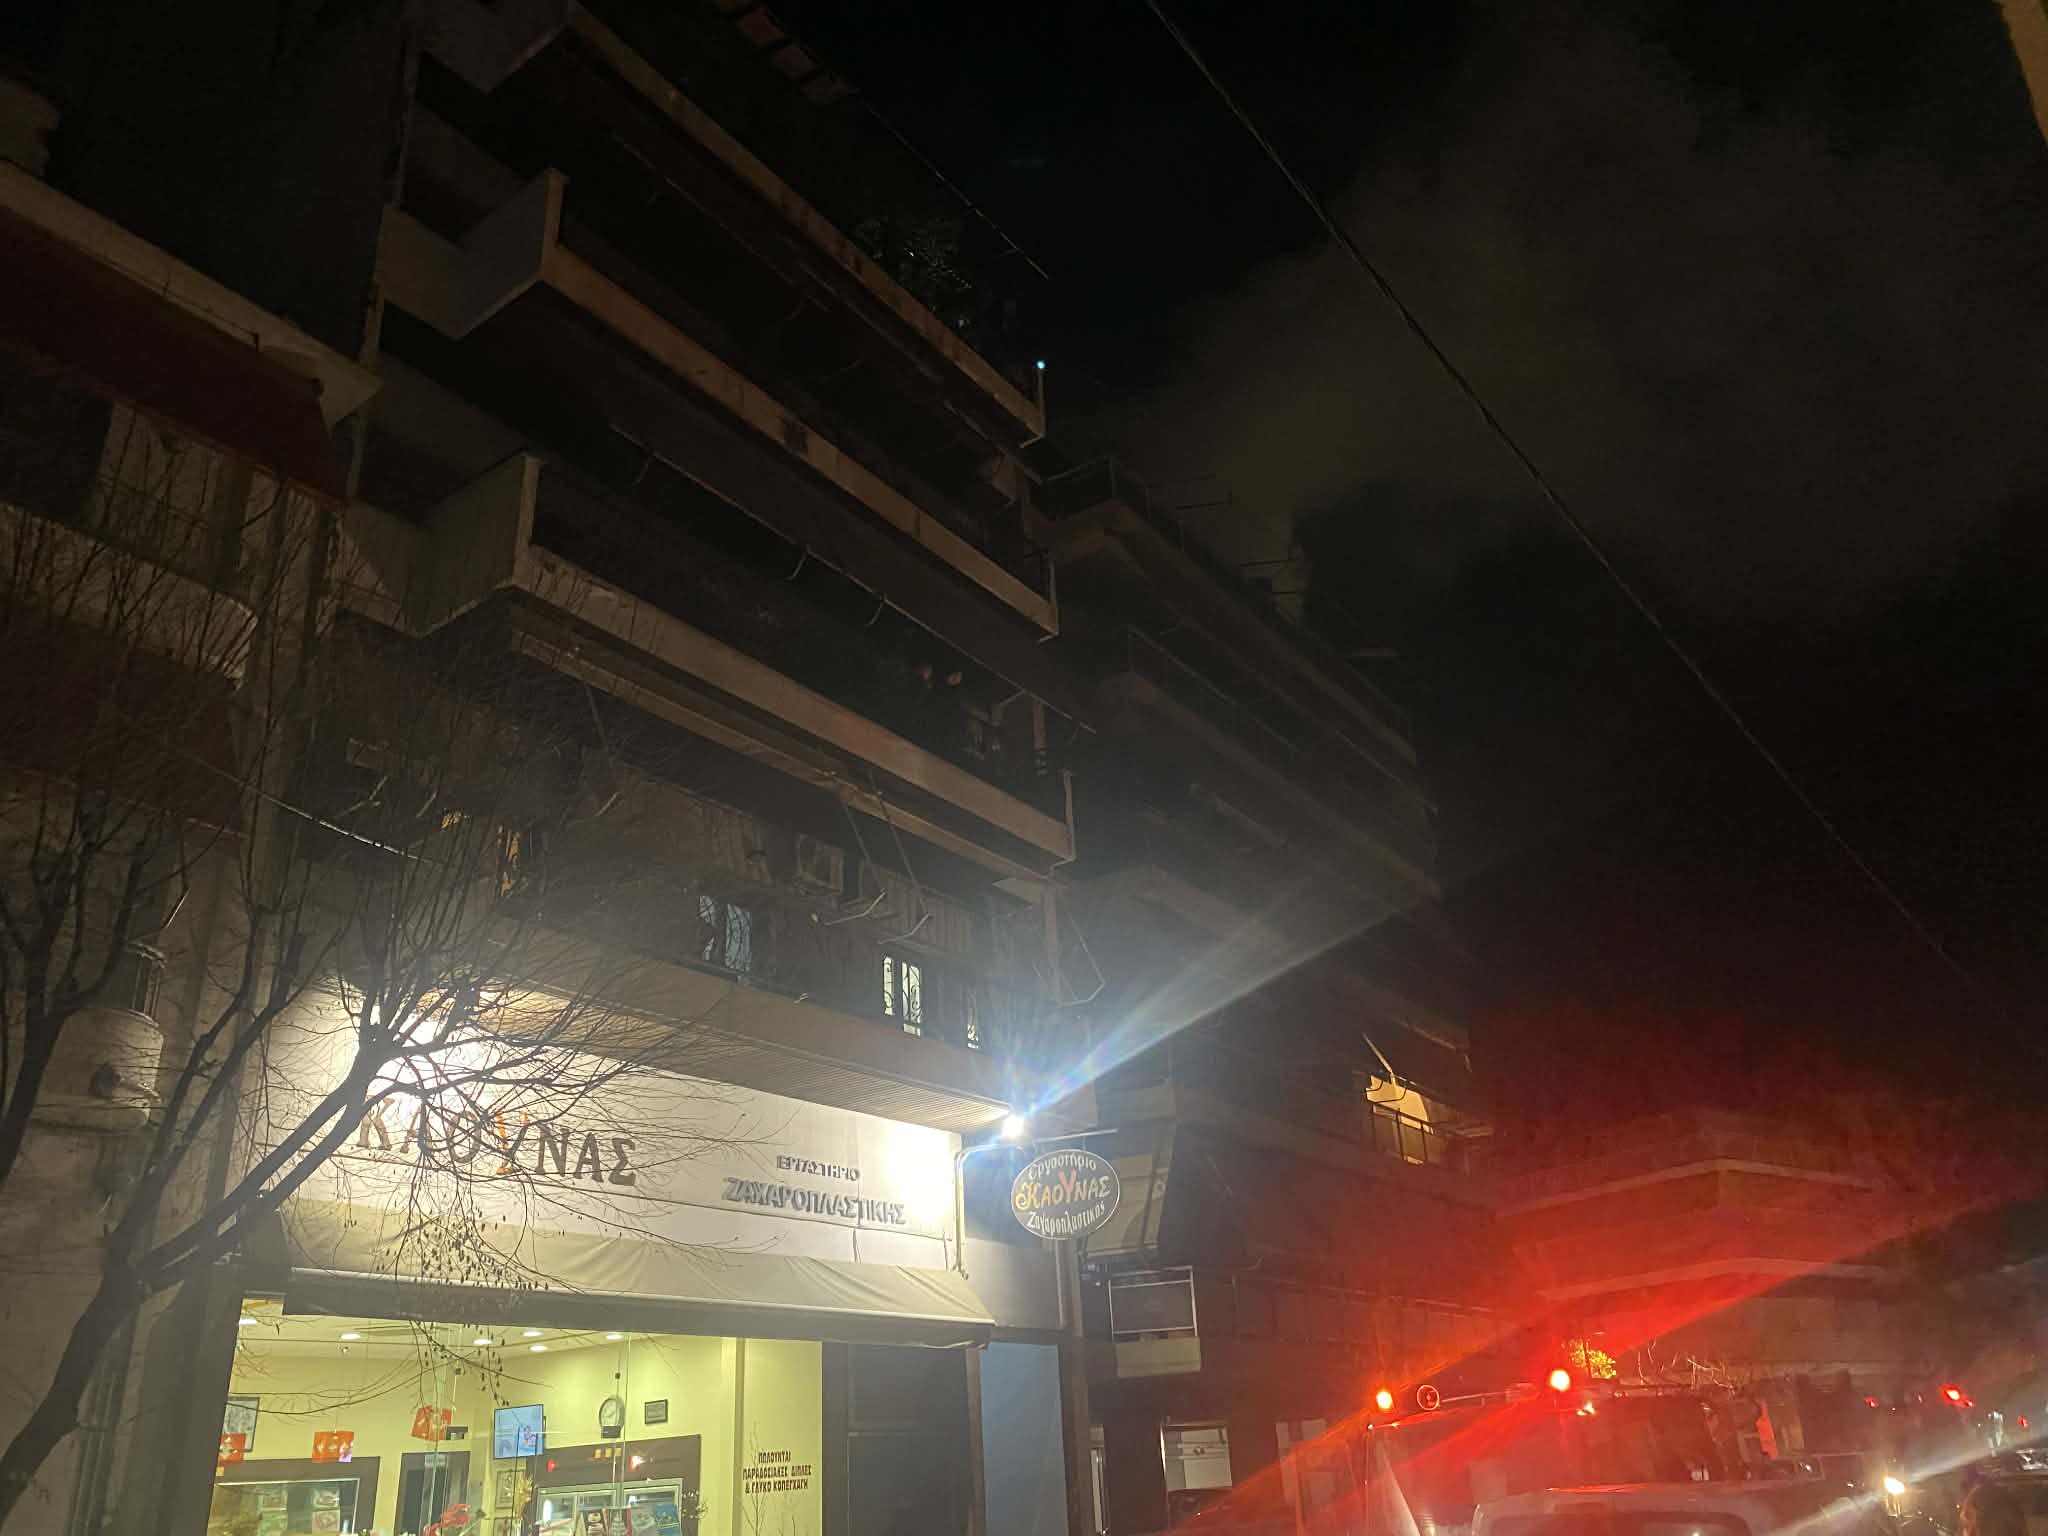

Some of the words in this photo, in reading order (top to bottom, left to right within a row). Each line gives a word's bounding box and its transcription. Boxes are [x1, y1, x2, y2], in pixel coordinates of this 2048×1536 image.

[776, 1155, 861, 1182] ΕΡΓΑΣΤΗΡΙΟ
[1014, 1168, 1111, 1211] ΚΑΟΥΝΑΣ
[722, 1177, 906, 1225] ΖΑΧΑΡΟΠΛΑΣΤΙΚΗΣ
[758, 1451, 791, 1464] ΠΩΛΟΥΝΤΑΙ
[743, 1466, 788, 1480] ΠΑΡΑΔΟΣΙΑΚΕΣ
[745, 1481, 750, 1494] &
[751, 1481, 772, 1493] ΓΛΥΚΟ
